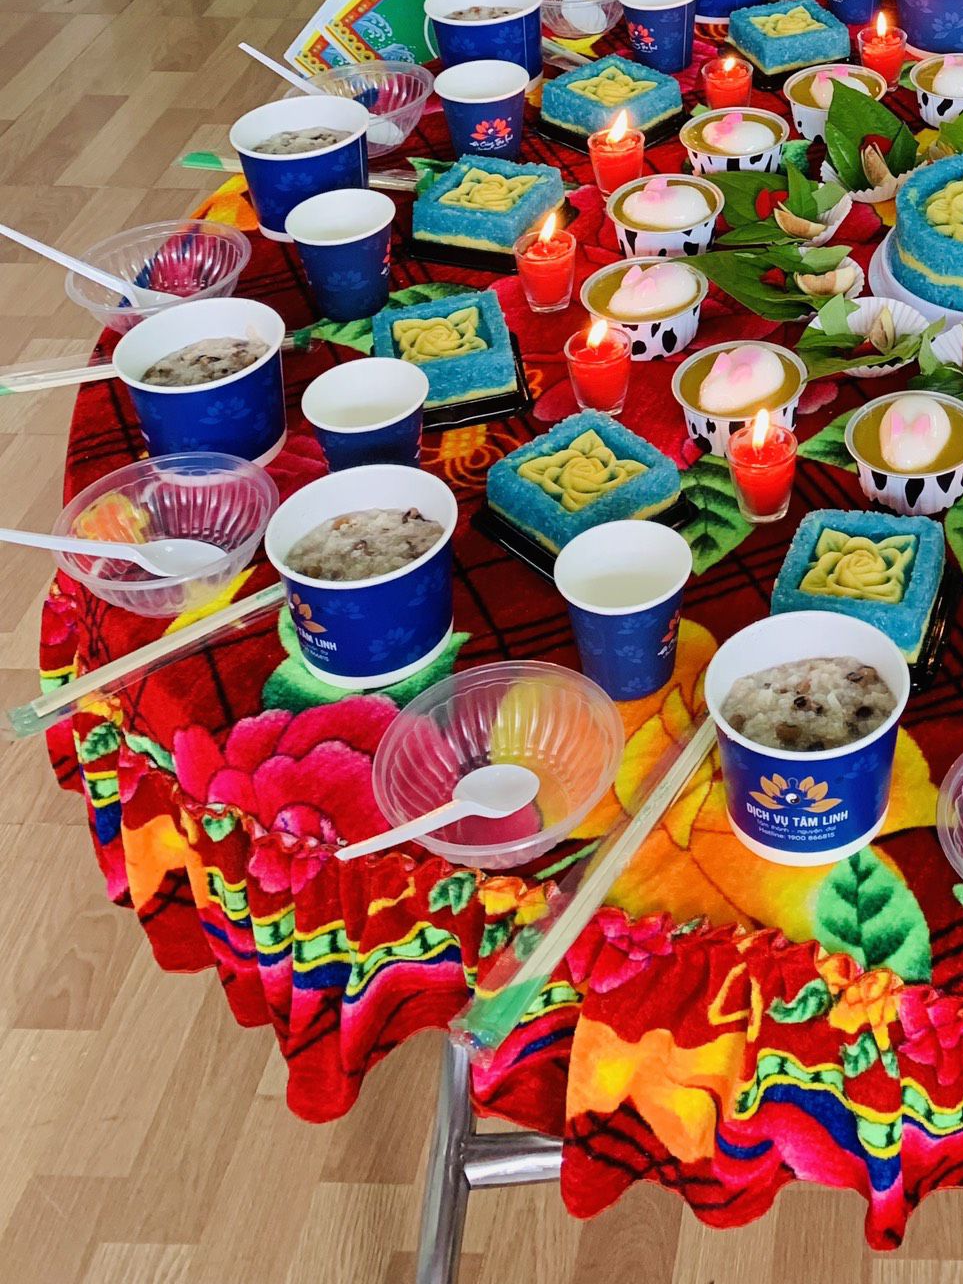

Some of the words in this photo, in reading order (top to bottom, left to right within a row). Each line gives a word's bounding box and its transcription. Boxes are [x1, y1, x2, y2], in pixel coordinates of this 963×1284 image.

[314, 637, 338, 651] LINH
[746, 802, 770, 821] DỊCH
[773, 814, 788, 828] VỤ
[792, 816, 818, 827] TÂM
[822, 810, 848, 826] LINH
